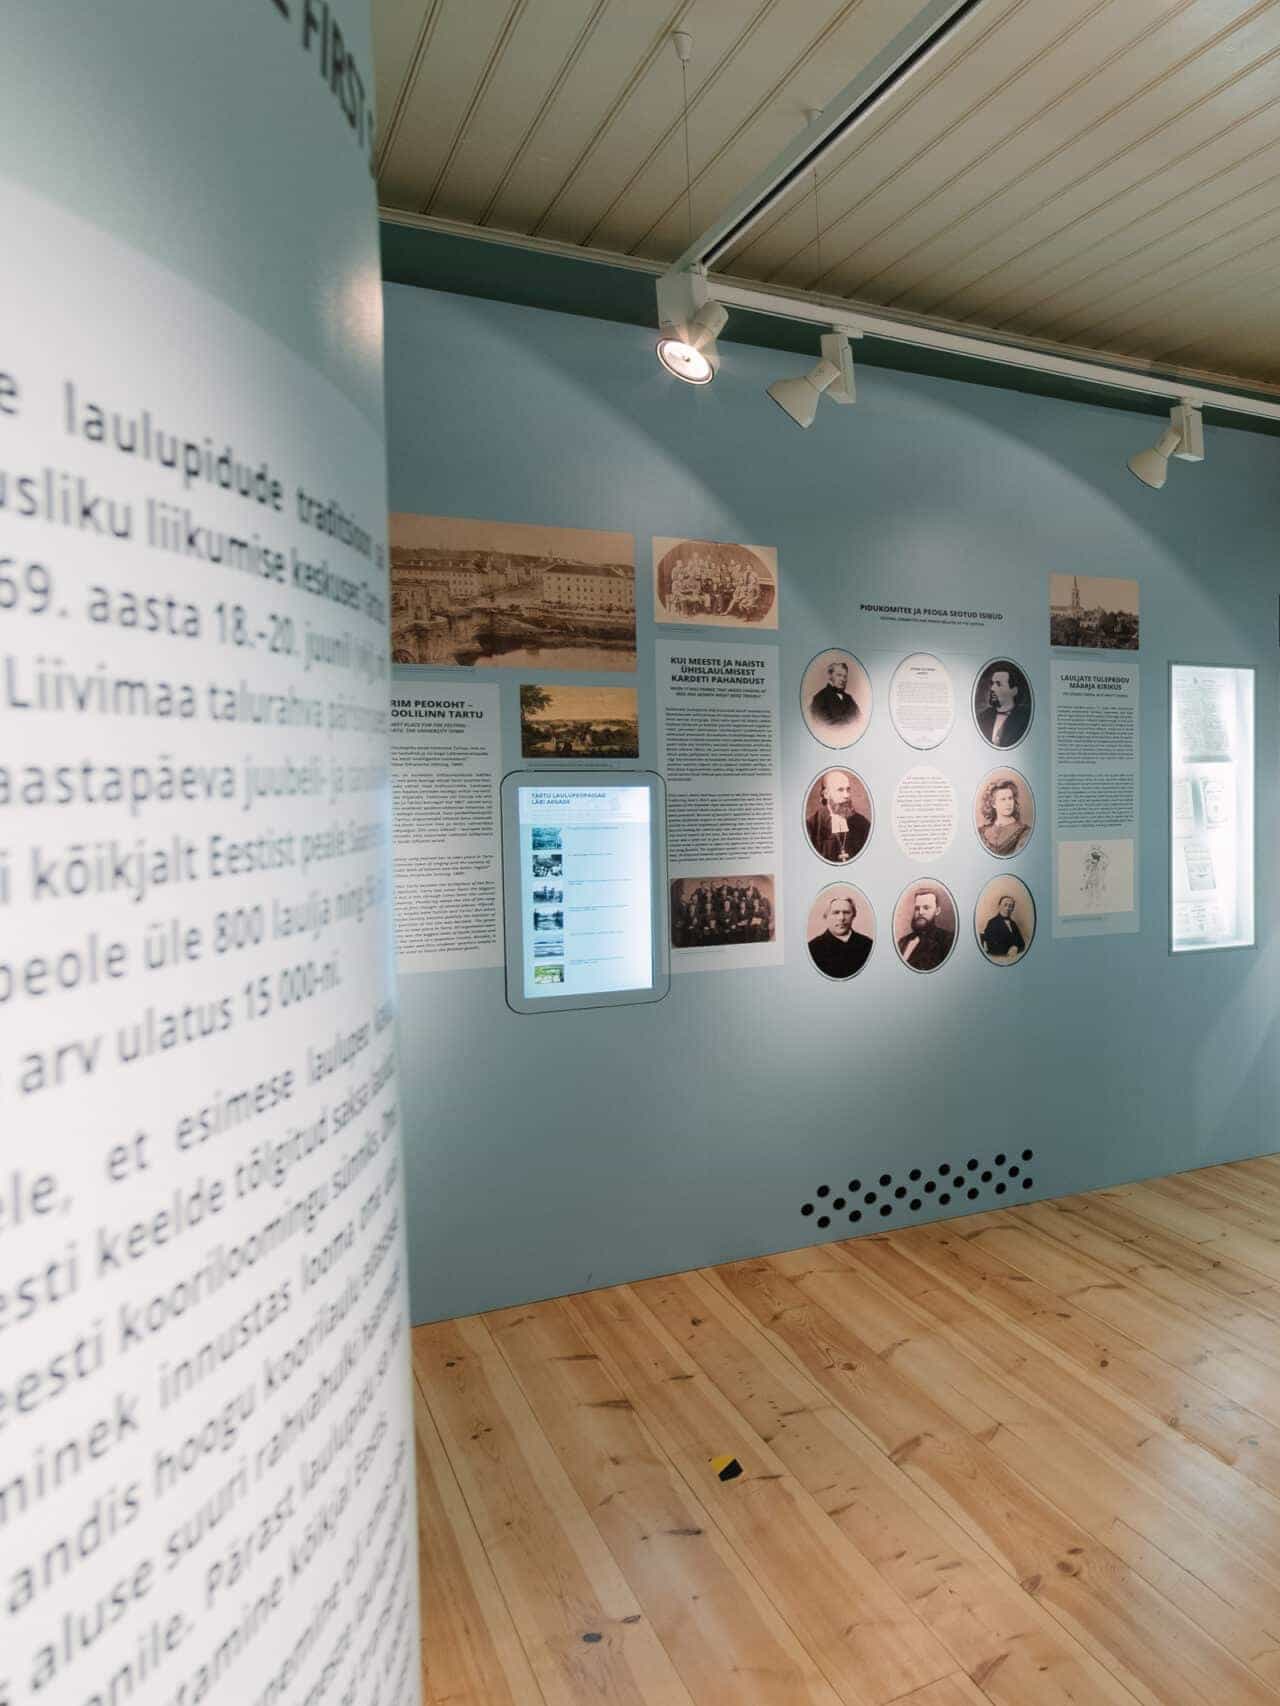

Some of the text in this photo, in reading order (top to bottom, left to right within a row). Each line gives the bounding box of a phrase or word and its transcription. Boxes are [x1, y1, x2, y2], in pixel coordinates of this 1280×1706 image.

[64, 380, 283, 512] laulupidude
[148, 498, 286, 584] liikumise
[87, 585, 201, 639] aasta
[860, 604, 912, 614] PIDUKOMITEE
[5, 654, 197, 719] Liivimaa
[414, 700, 465, 708] PEOKOHT
[672, 674, 765, 684] KARDETI PAHANDUST
[688, 658, 721, 666] MEESTE
[723, 659, 733, 668] JA
[448, 710, 484, 718] TARTU
[31, 835, 198, 903] kõikjalt
[208, 826, 296, 878] Eestist
[144, 917, 202, 971] üle
[213, 904, 264, 954] 800
[18, 1032, 102, 1096] arv
[116, 995, 233, 1064] ulatus
[244, 967, 272, 1018] 15
[0, 1168, 73, 1226] le,
[105, 1127, 148, 1184] et
[175, 1064, 294, 1153] esimese
[0, 1238, 78, 1332] sti
[95, 1176, 224, 1280] keelde
[234, 1105, 328, 1199] tõlgitud
[0, 1316, 103, 1426] esti
[158, 1277, 292, 1412] innustas
[7, 1481, 140, 1616] andis
[155, 1384, 256, 1500] hoogu
[204, 1484, 295, 1610] Pärast
[30, 1557, 155, 1694] aluse
